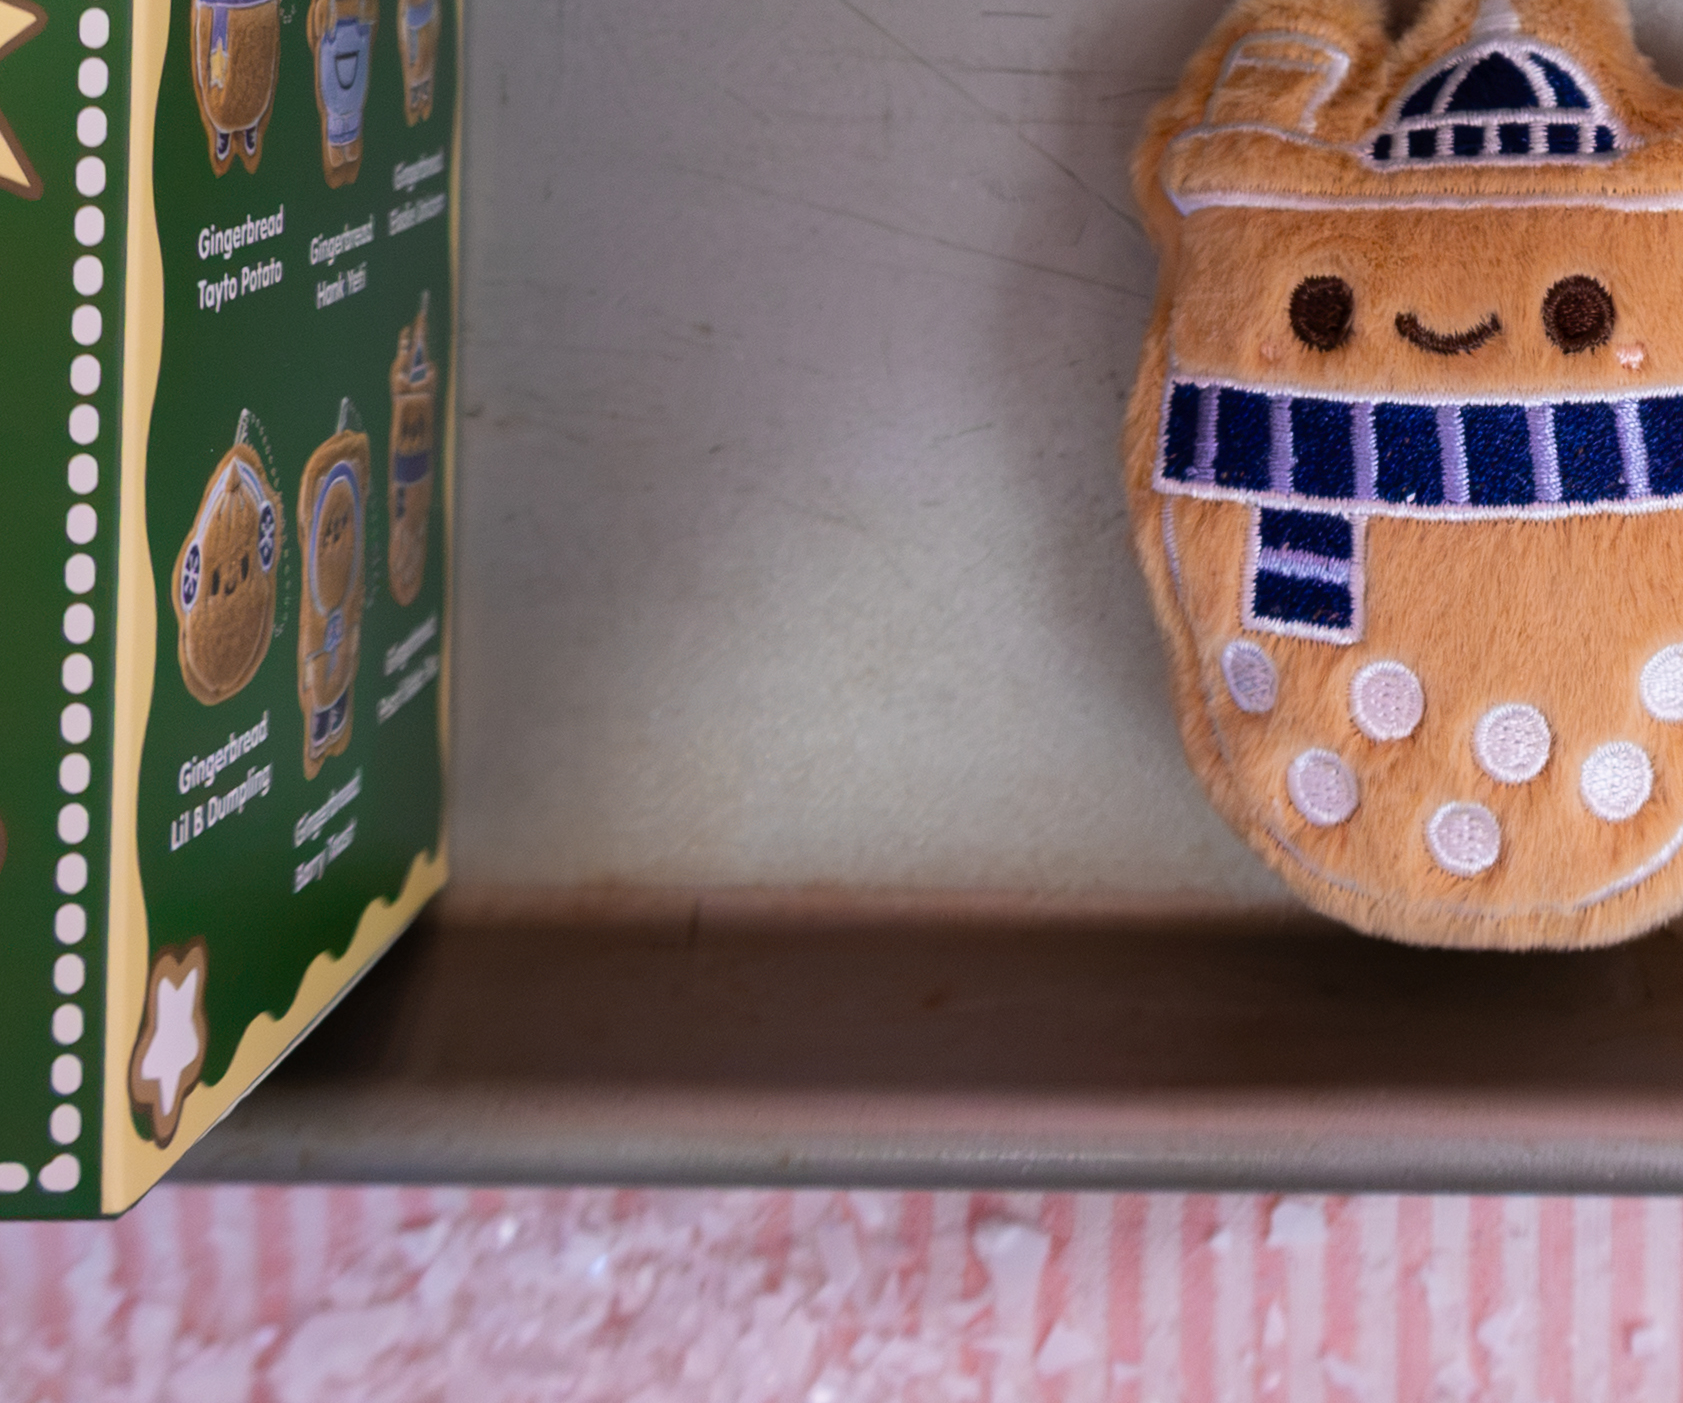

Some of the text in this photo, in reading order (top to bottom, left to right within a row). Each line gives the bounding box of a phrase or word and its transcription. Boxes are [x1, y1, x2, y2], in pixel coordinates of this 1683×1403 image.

[198, 203, 284, 261] Gingerbread
[196, 257, 283, 314] Tayto Potato
[178, 709, 269, 796] Gingerbread
[192, 804, 205, 838] B
